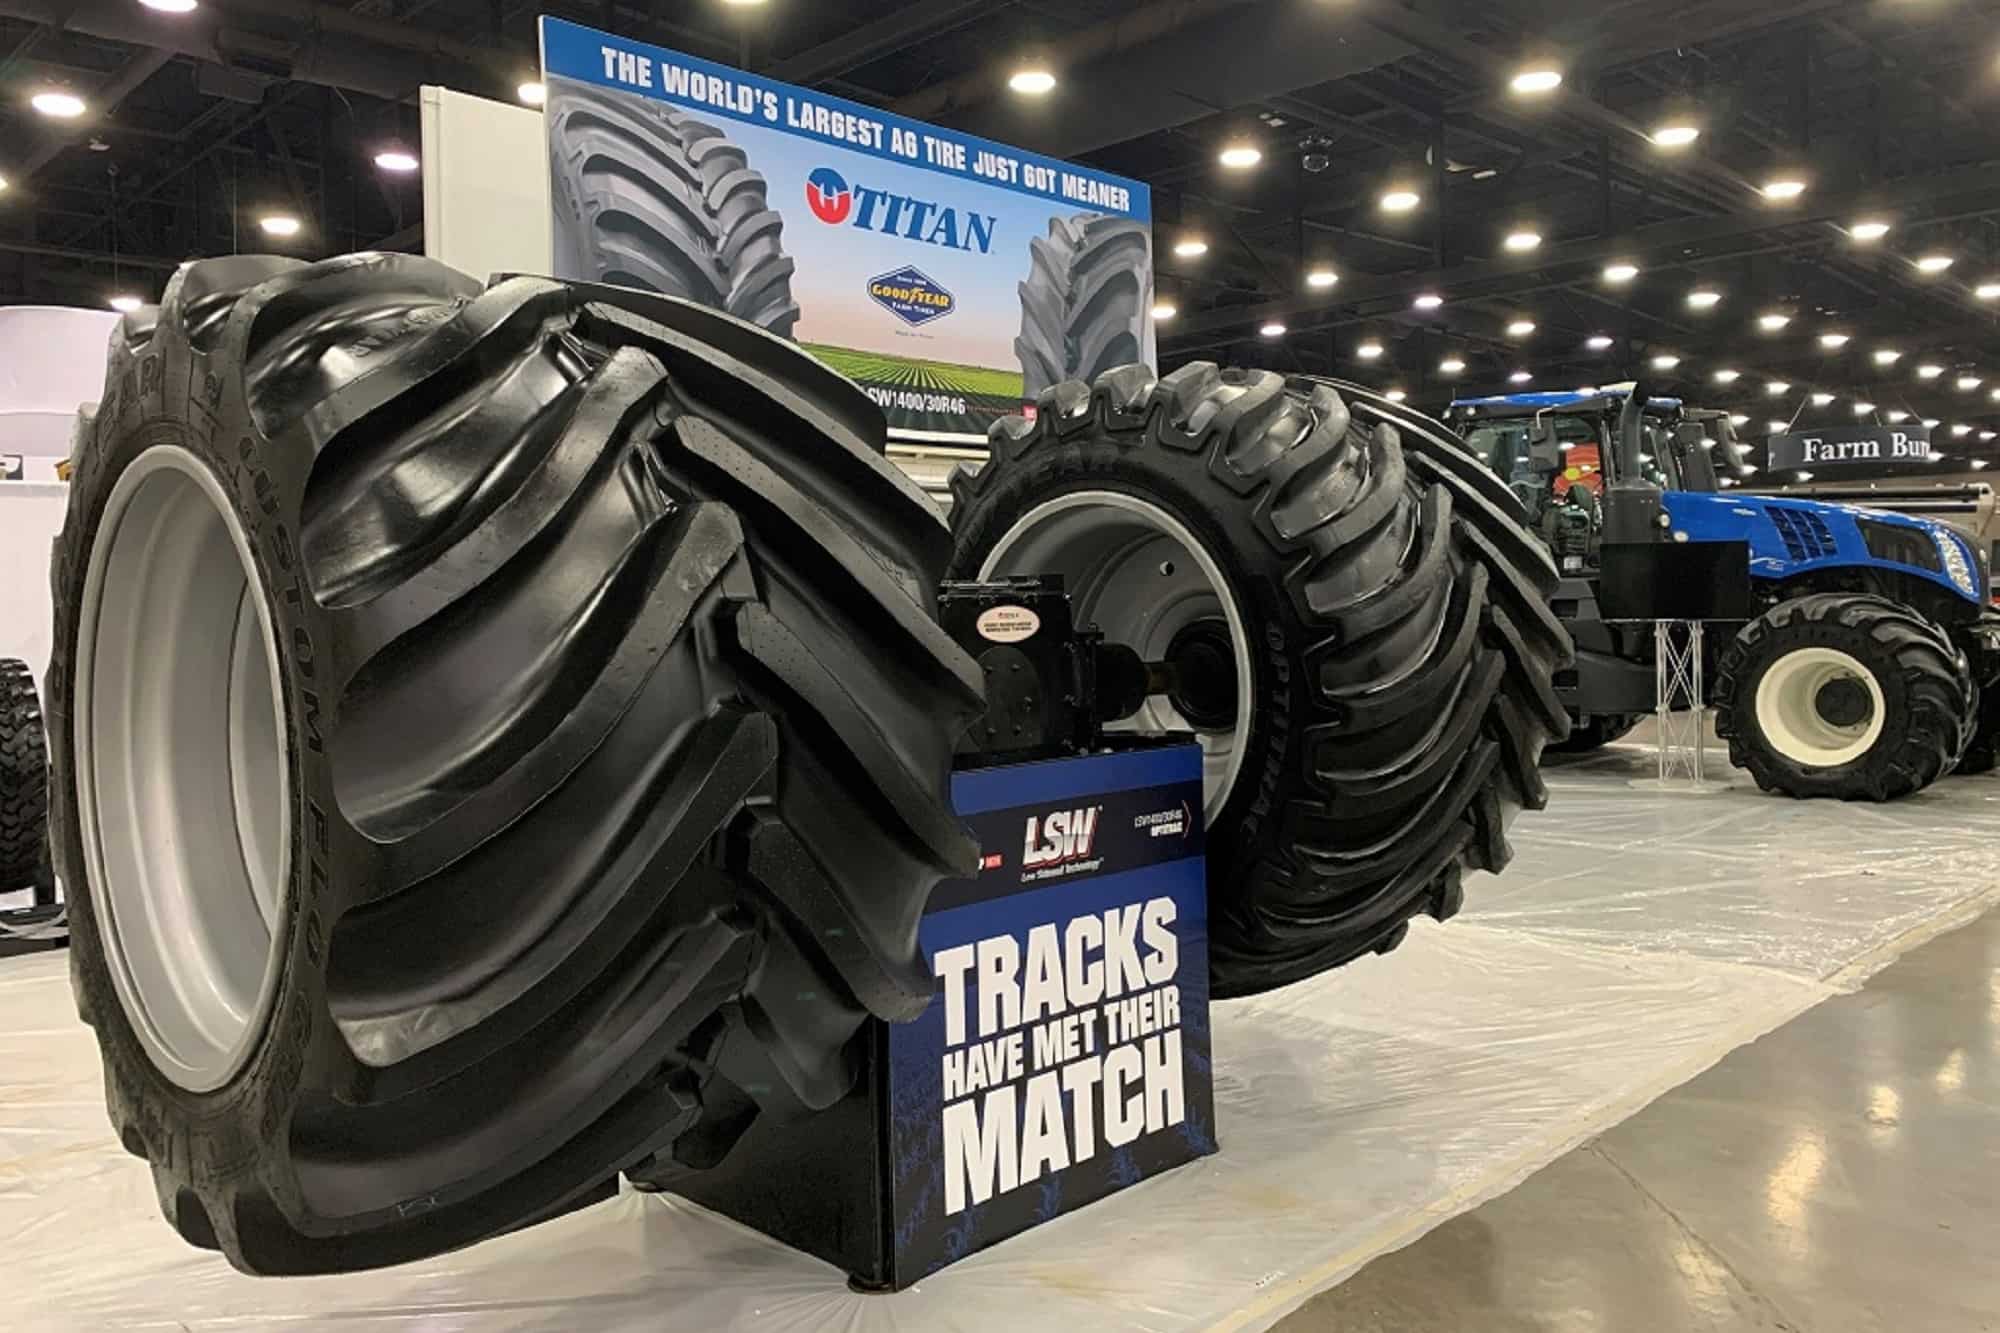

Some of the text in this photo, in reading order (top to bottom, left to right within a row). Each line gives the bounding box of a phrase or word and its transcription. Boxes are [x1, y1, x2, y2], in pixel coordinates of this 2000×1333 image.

[601, 46, 1130, 212] THE WORLD'S LARGEST AG TIRE JUST GOT MEANER
[852, 184, 997, 254] TITAN
[872, 283, 950, 307] GOODYEAR
[1802, 438, 1881, 462] Farm
[1022, 806, 1098, 867] LSW
[933, 896, 1179, 1047] TRACKS
[942, 985, 1181, 1101] HAVE MET THEIR
[942, 1028, 1185, 1216] MATCH
